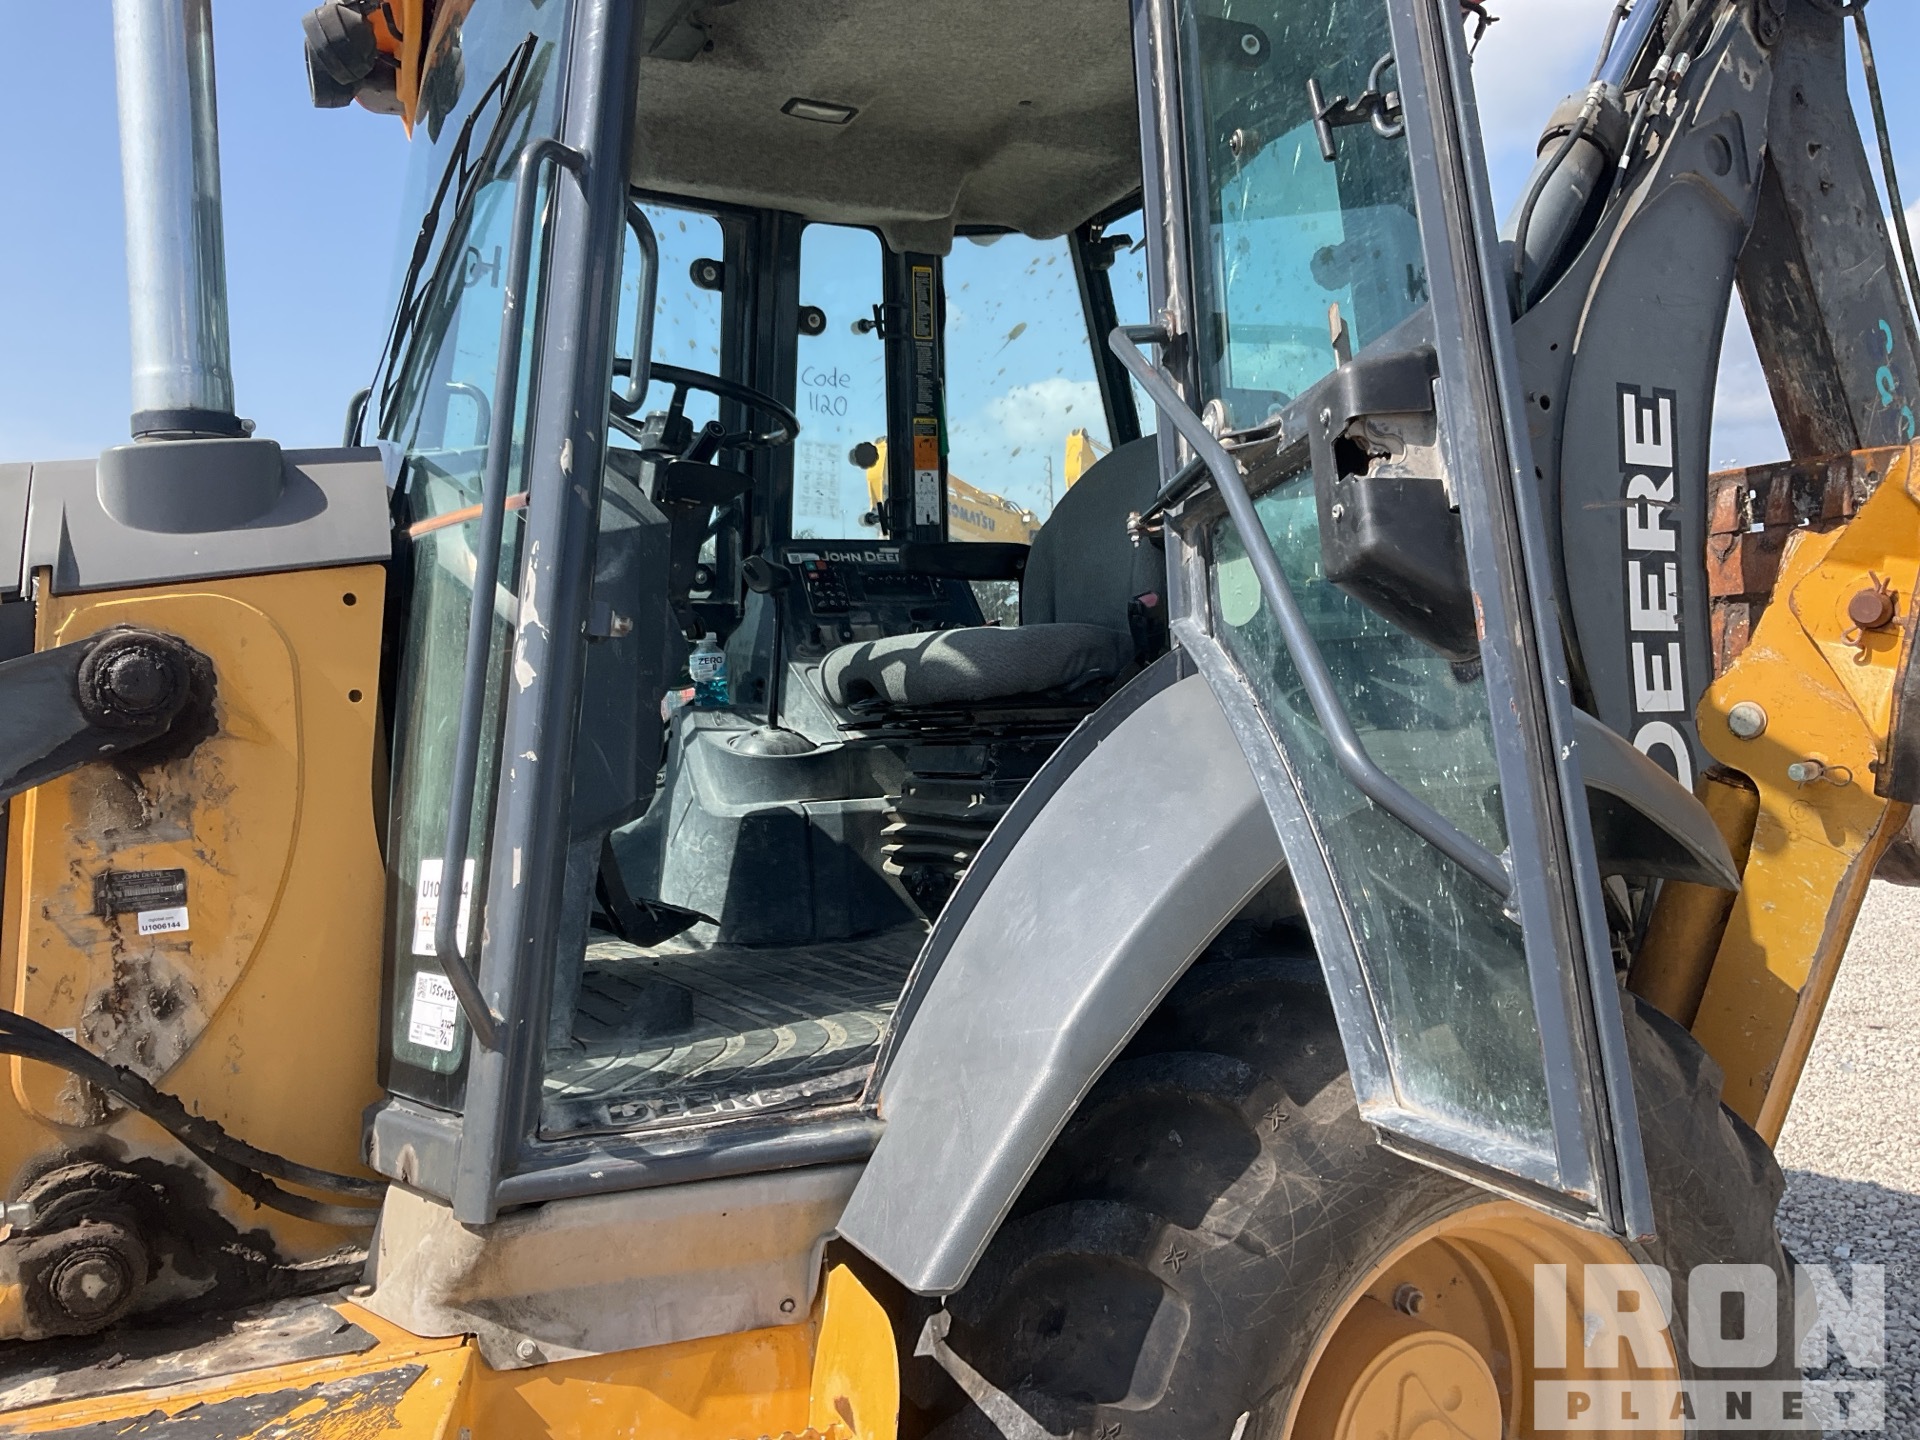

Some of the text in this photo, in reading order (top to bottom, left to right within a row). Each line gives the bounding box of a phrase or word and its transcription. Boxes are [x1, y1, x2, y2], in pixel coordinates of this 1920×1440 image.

[801, 366, 851, 389] Code
[809, 391, 848, 417] 1120
[948, 502, 995, 532] OMATSU
[821, 550, 900, 563] JOHN DEE
[698, 656, 723, 665] ZERO
[422, 880, 469, 899] U104
[141, 921, 181, 931] U1006144
